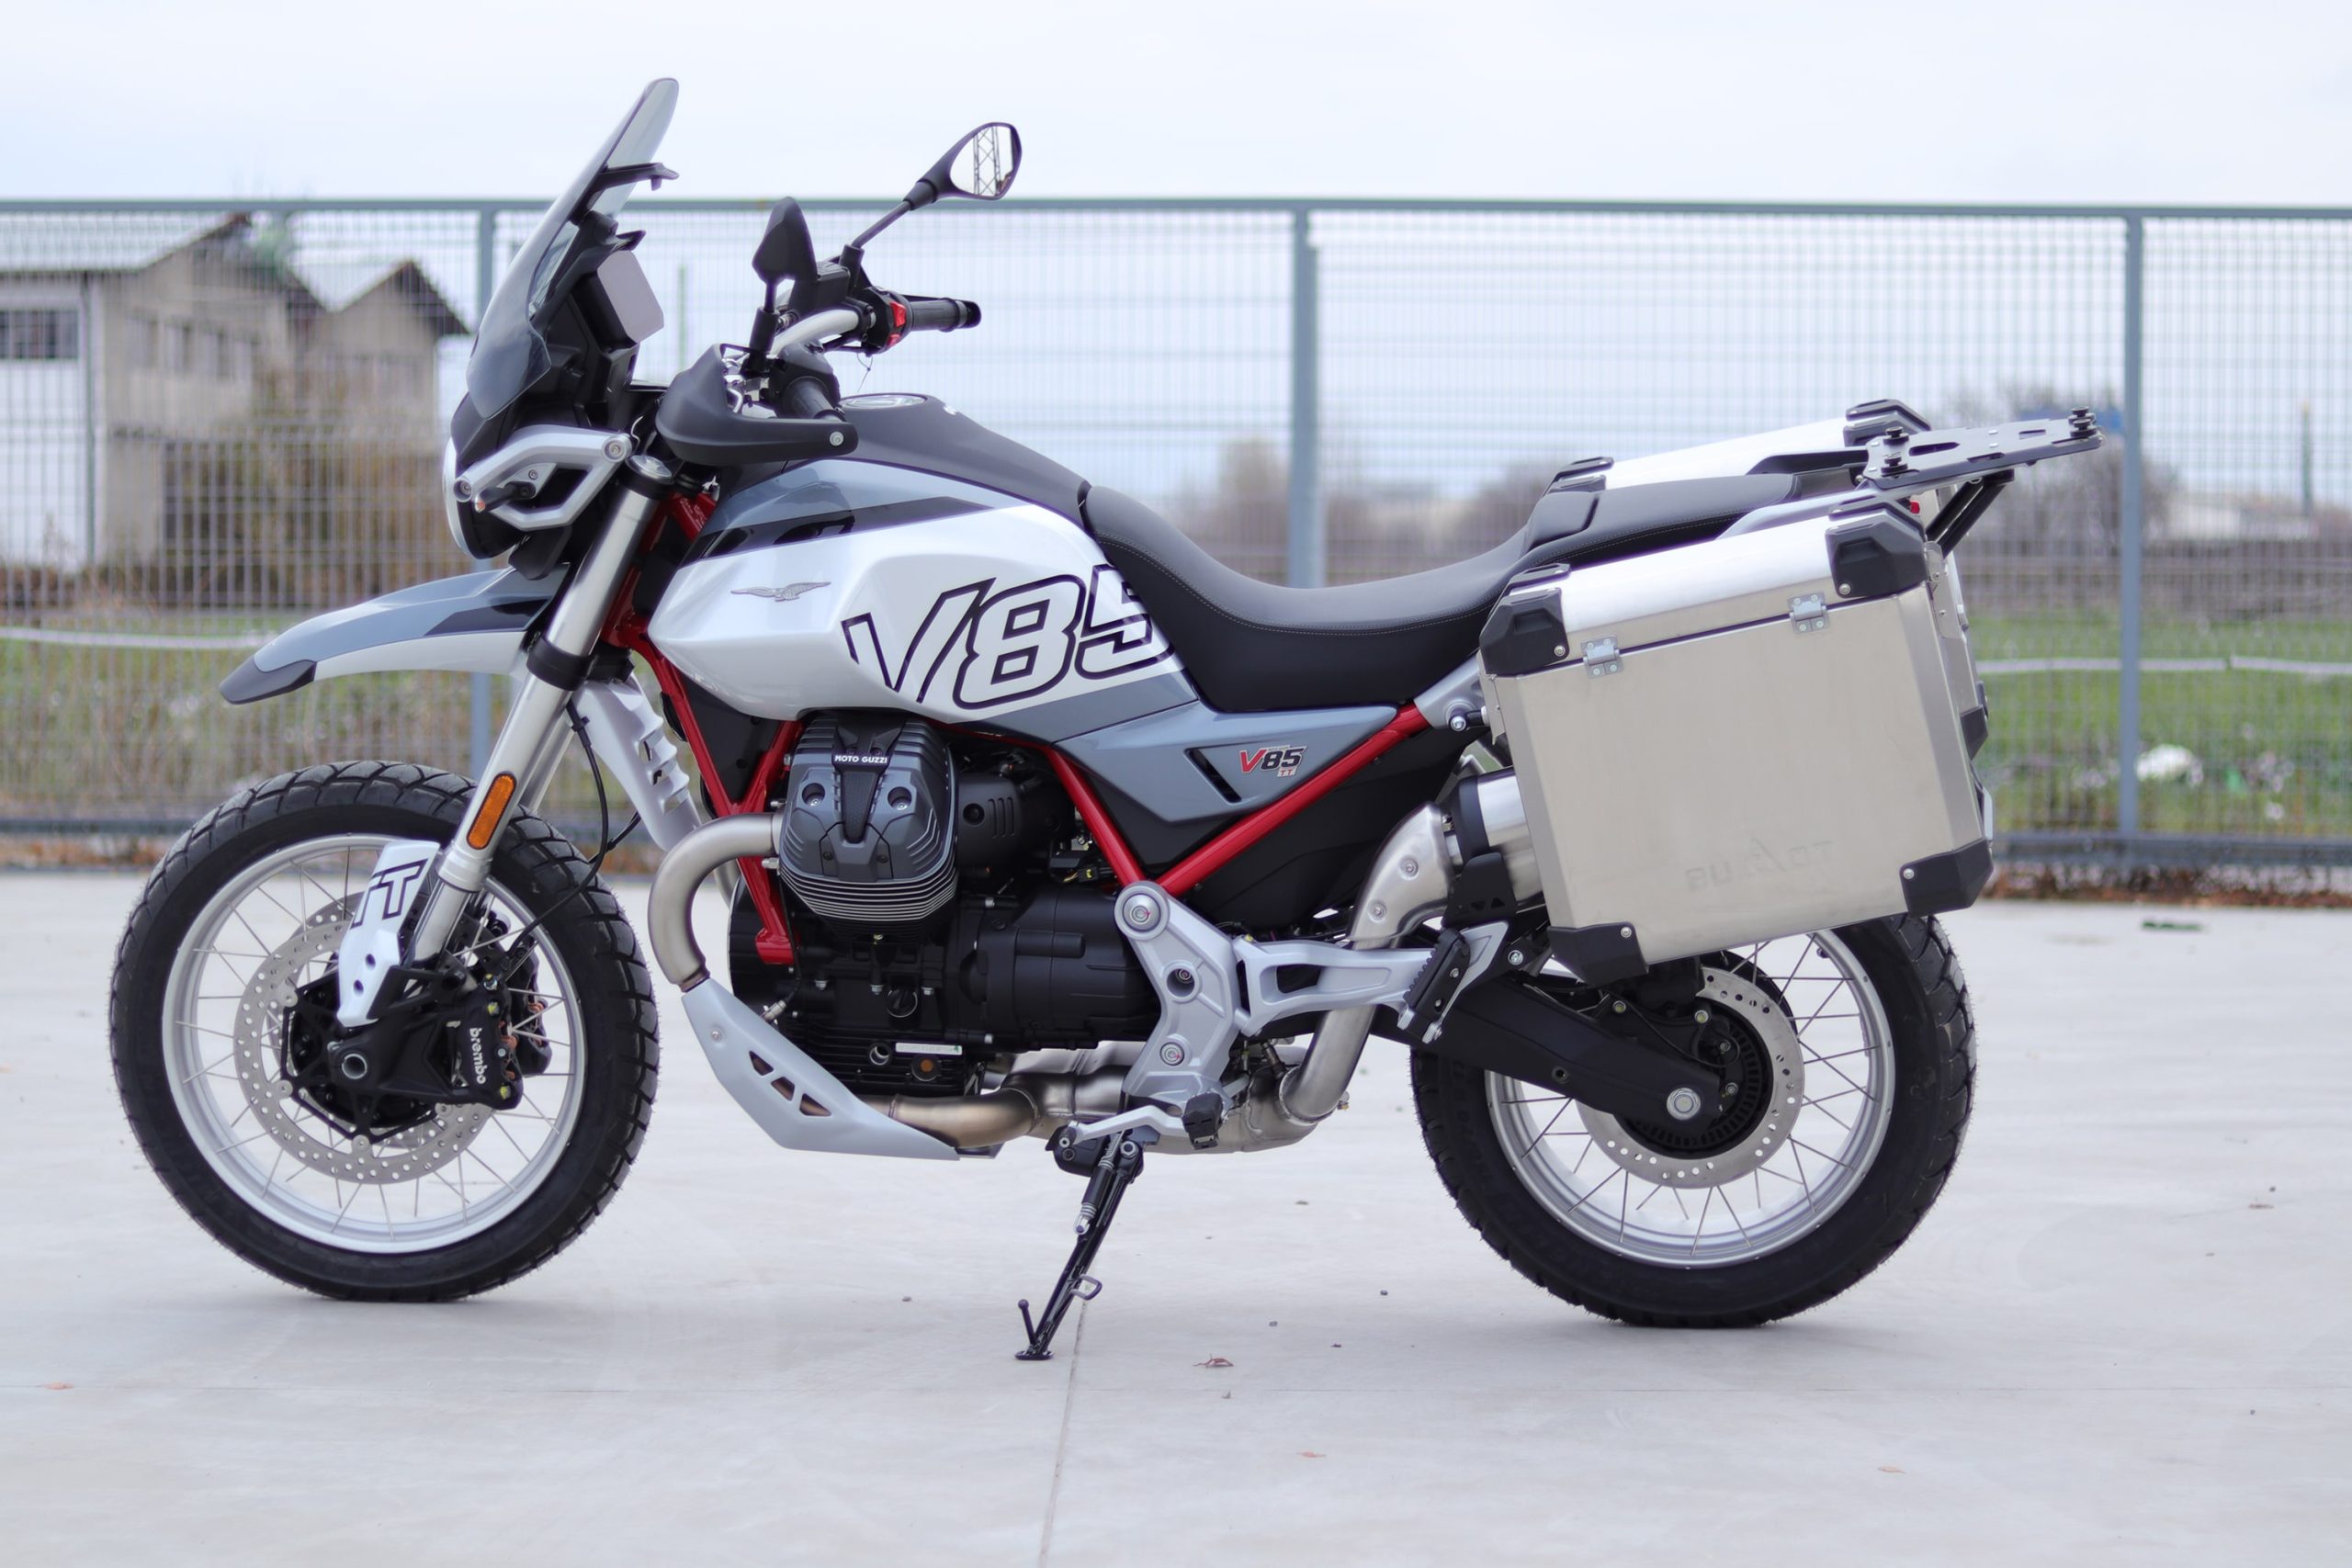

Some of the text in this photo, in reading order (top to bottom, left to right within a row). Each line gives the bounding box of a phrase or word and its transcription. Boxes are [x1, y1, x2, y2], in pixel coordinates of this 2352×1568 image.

[841, 564, 1175, 710] V85
[1239, 746, 1306, 773] V85
[469, 1028, 488, 1084] brembo
